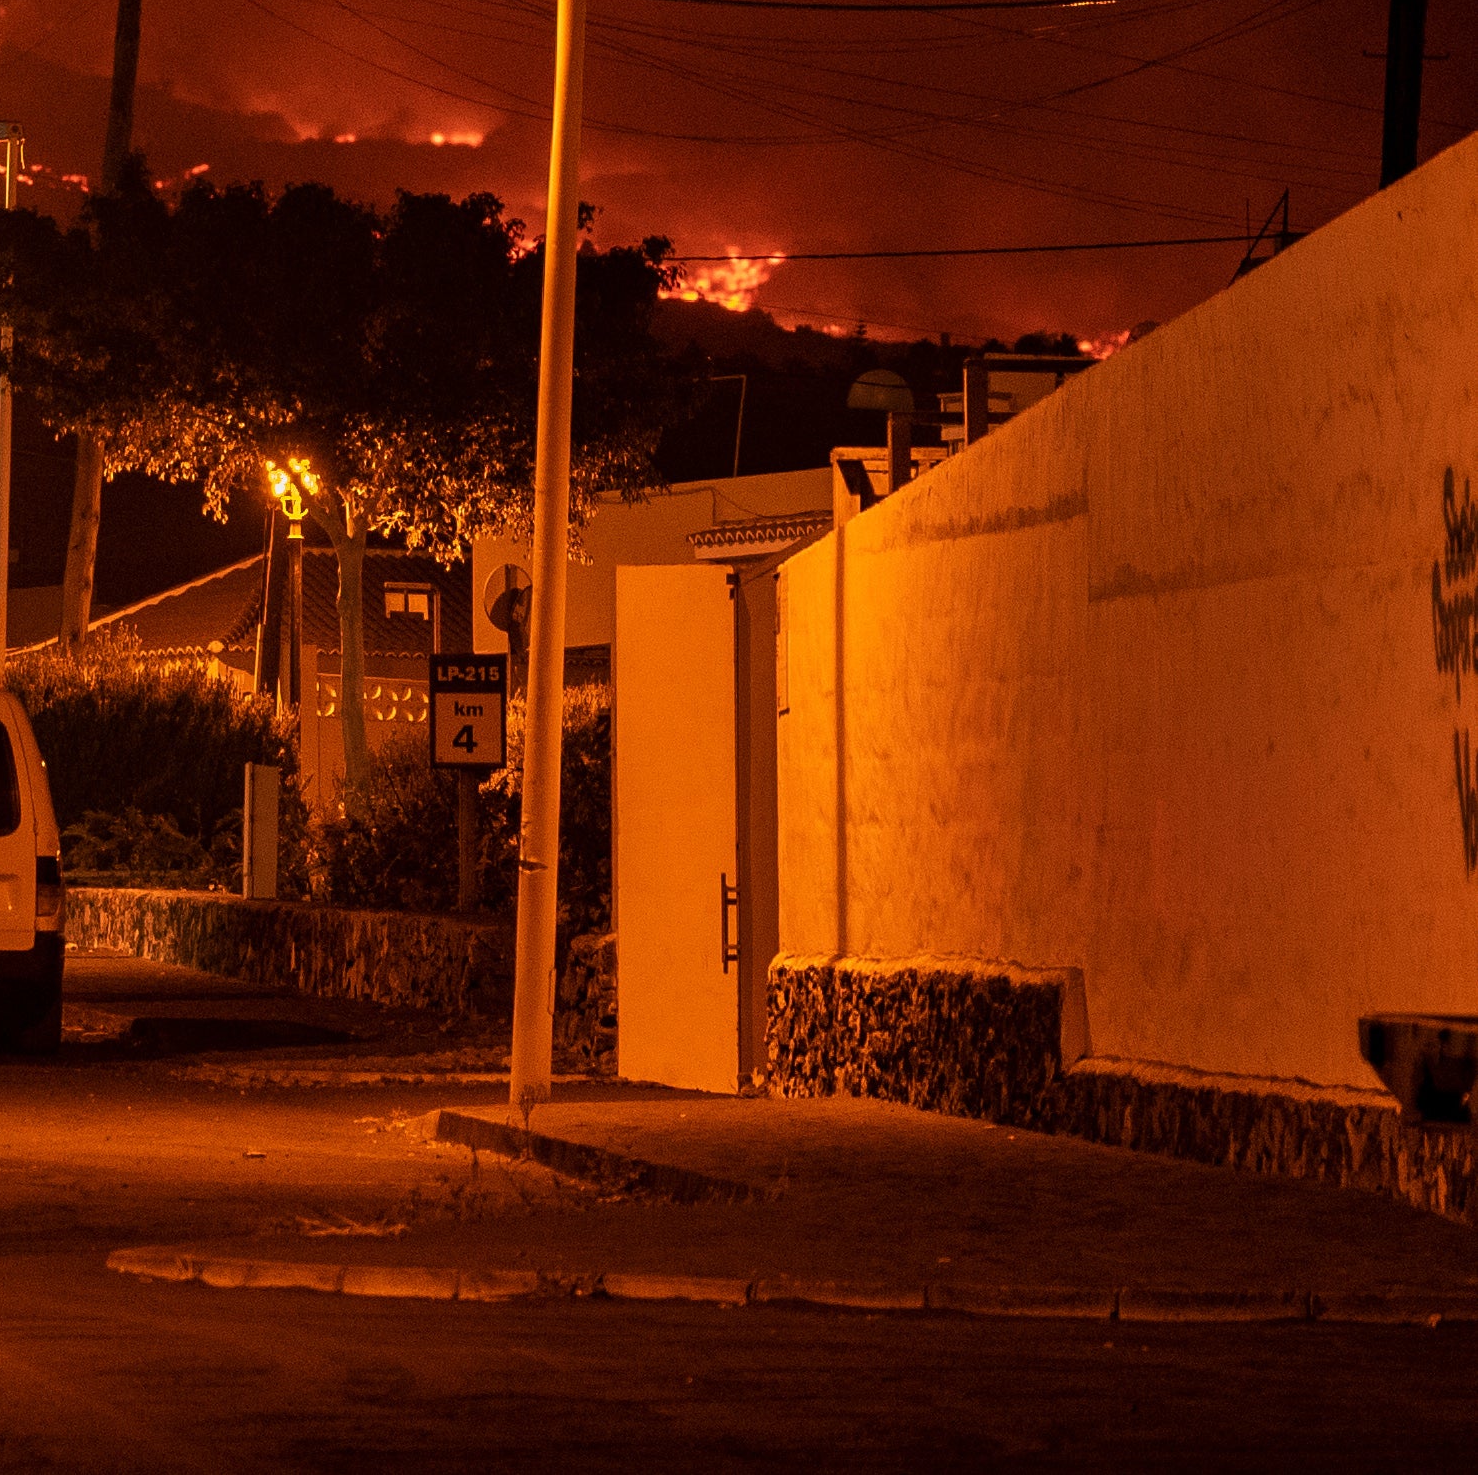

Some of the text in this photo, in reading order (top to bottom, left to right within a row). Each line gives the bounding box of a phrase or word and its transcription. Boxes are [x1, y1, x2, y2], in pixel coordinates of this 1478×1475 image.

[437, 666, 499, 681] LP-215
[454, 702, 483, 716] km
[453, 724, 477, 753] 4
